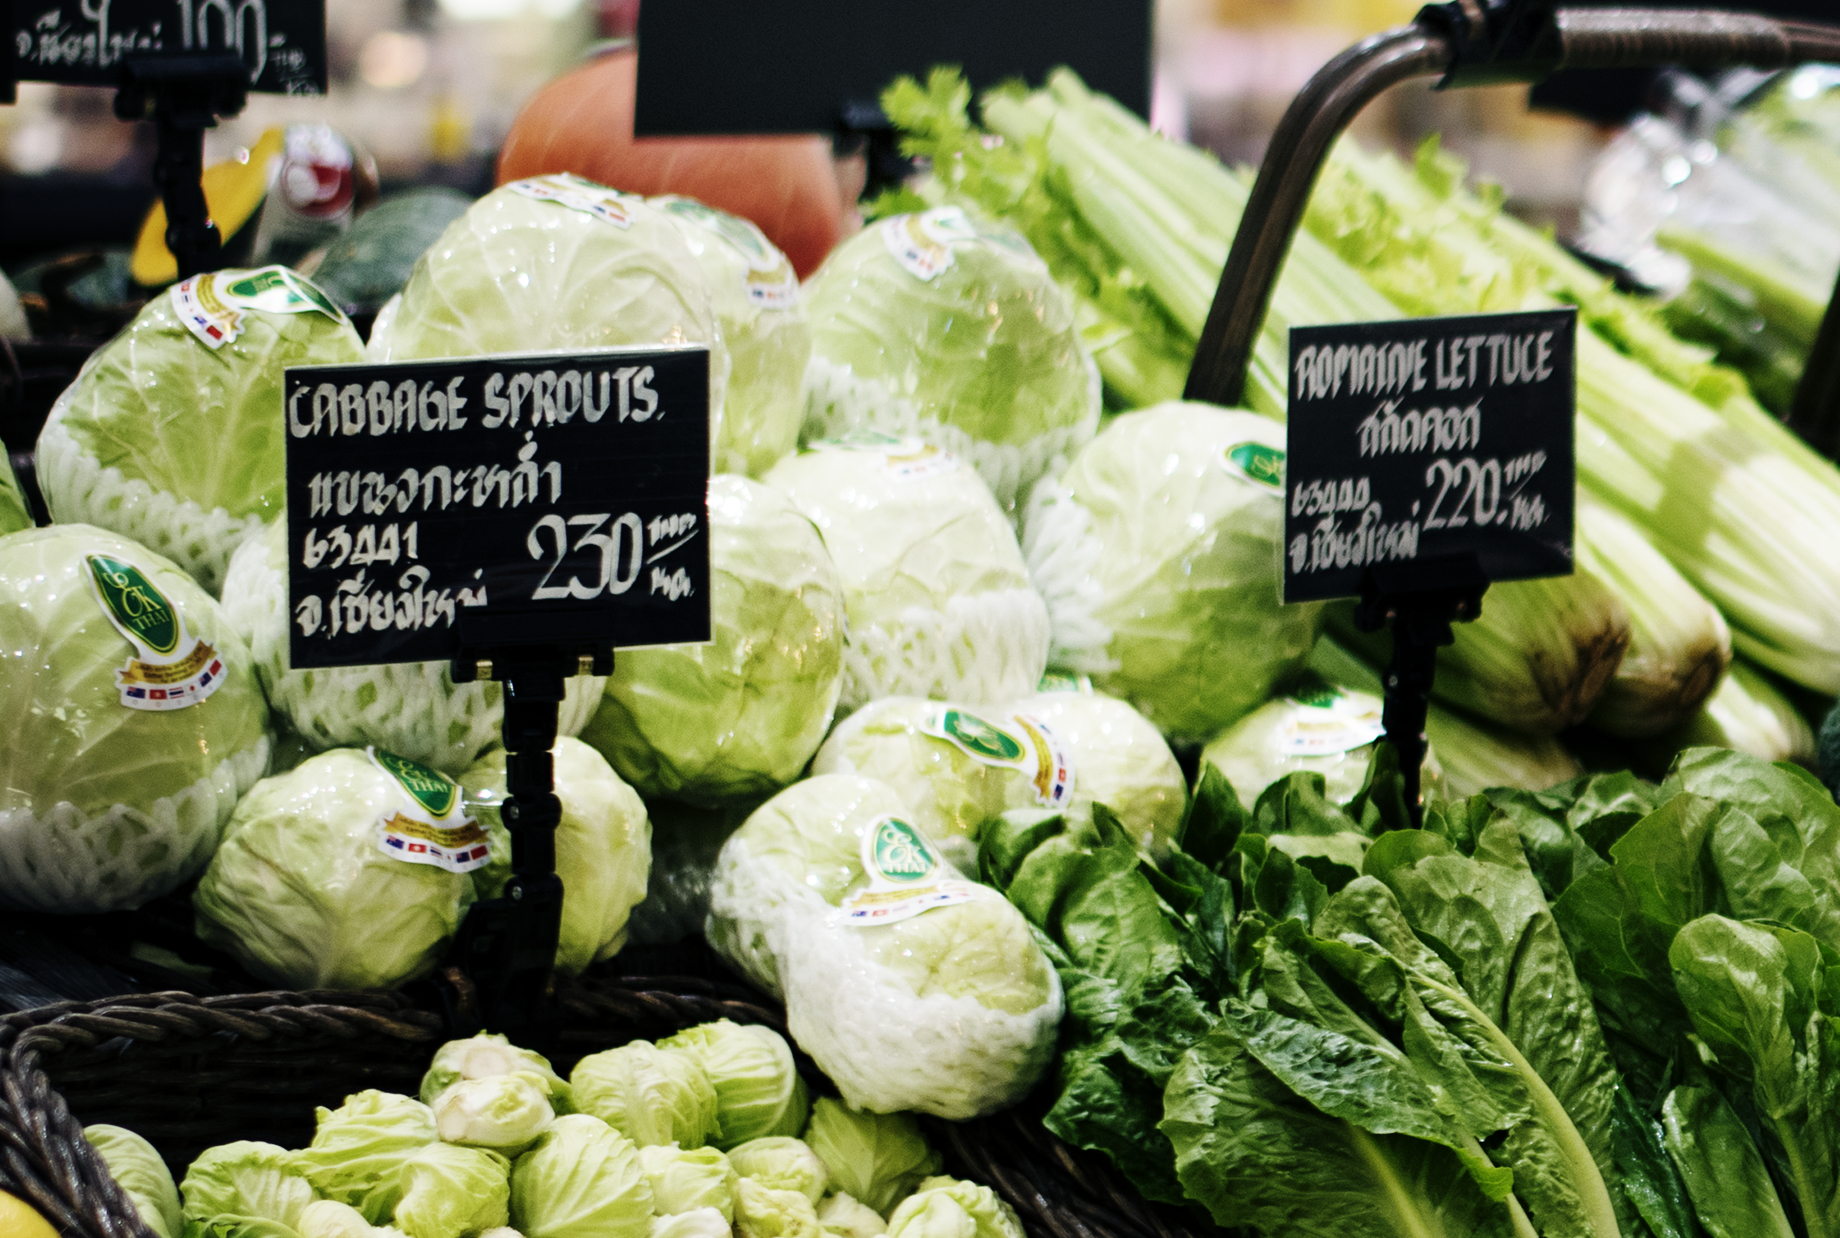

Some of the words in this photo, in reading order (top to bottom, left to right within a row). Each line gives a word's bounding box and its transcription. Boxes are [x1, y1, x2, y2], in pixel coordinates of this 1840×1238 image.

[1294, 338, 1428, 401] ROMAINE
[1435, 331, 1554, 390] LETTUCE
[288, 376, 468, 438] CABBAGE
[527, 511, 643, 600] 230
[132, 609, 170, 631] THAI
